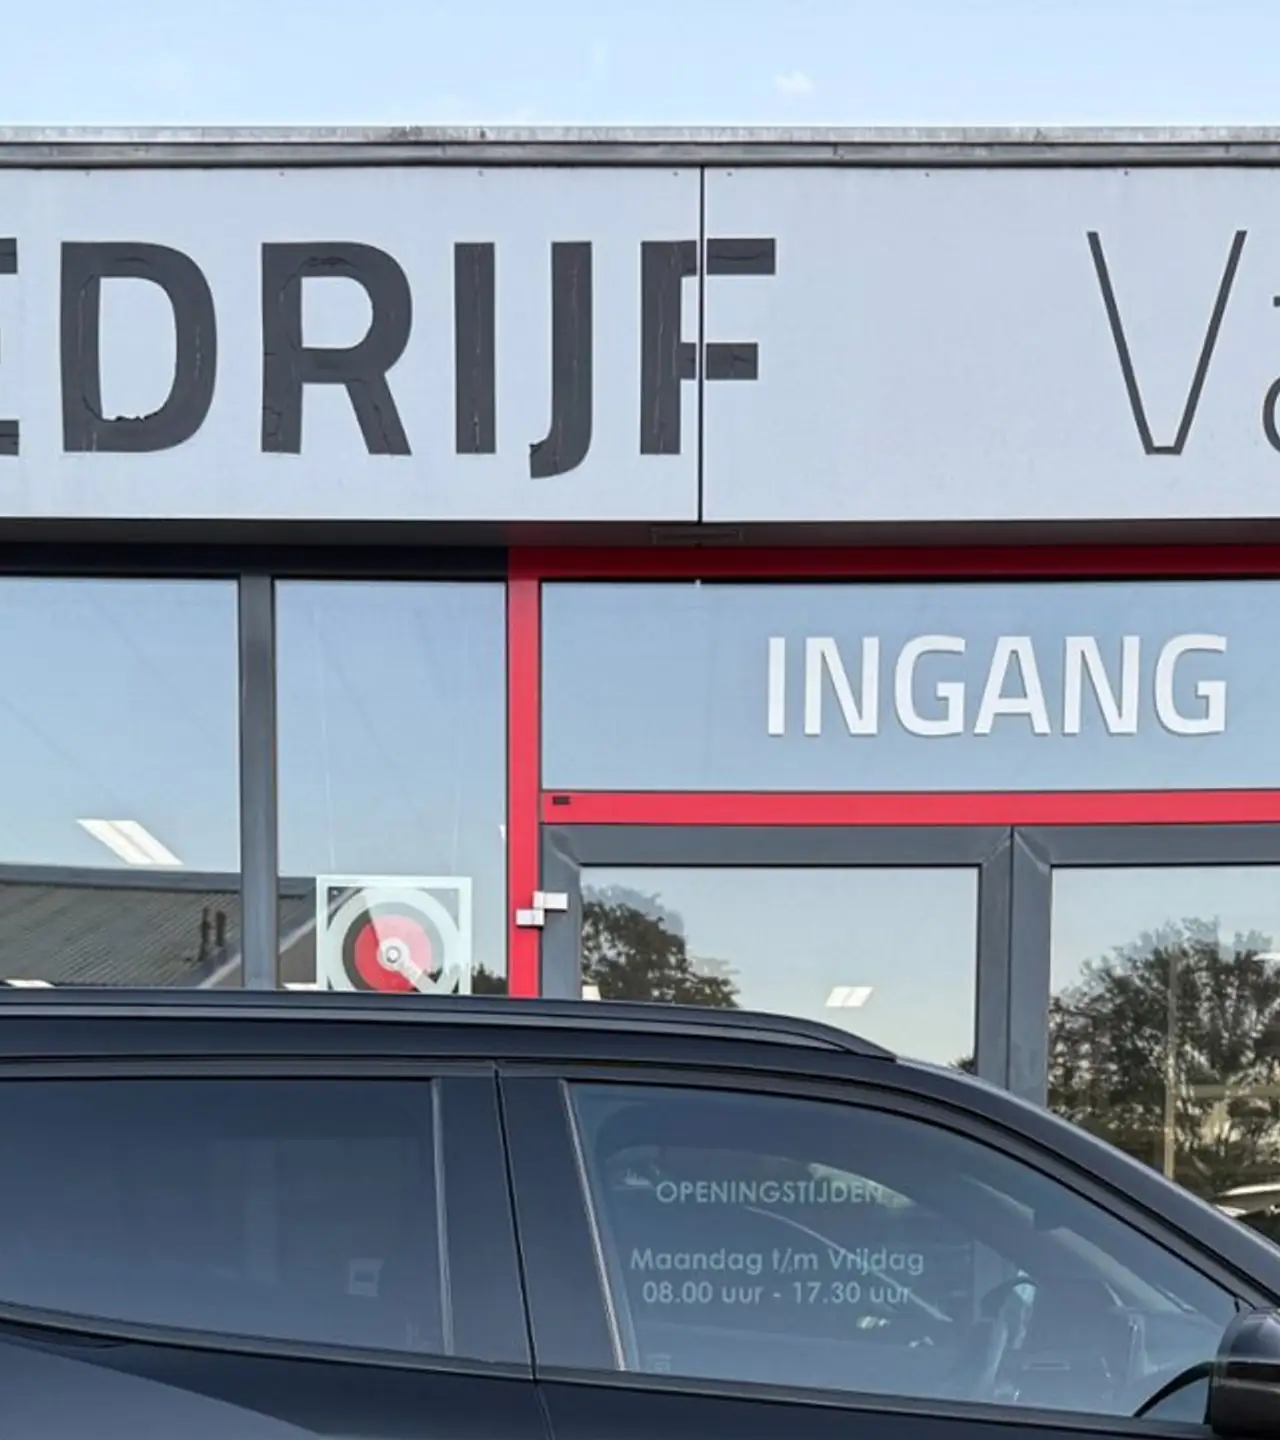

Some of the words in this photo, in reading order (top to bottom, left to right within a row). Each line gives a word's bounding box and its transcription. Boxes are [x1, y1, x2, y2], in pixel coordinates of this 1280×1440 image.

[766, 633, 1229, 737] INGANG
[656, 1180, 883, 1204] OPENINGSTIJDEN
[630, 1247, 763, 1275] Maandag
[828, 1247, 925, 1275] Vrijdag
[642, 1280, 713, 1304] 08.00
[721, 1285, 764, 1304] uur
[793, 1280, 862, 1304] 17.30
[869, 1285, 911, 1304] uur
